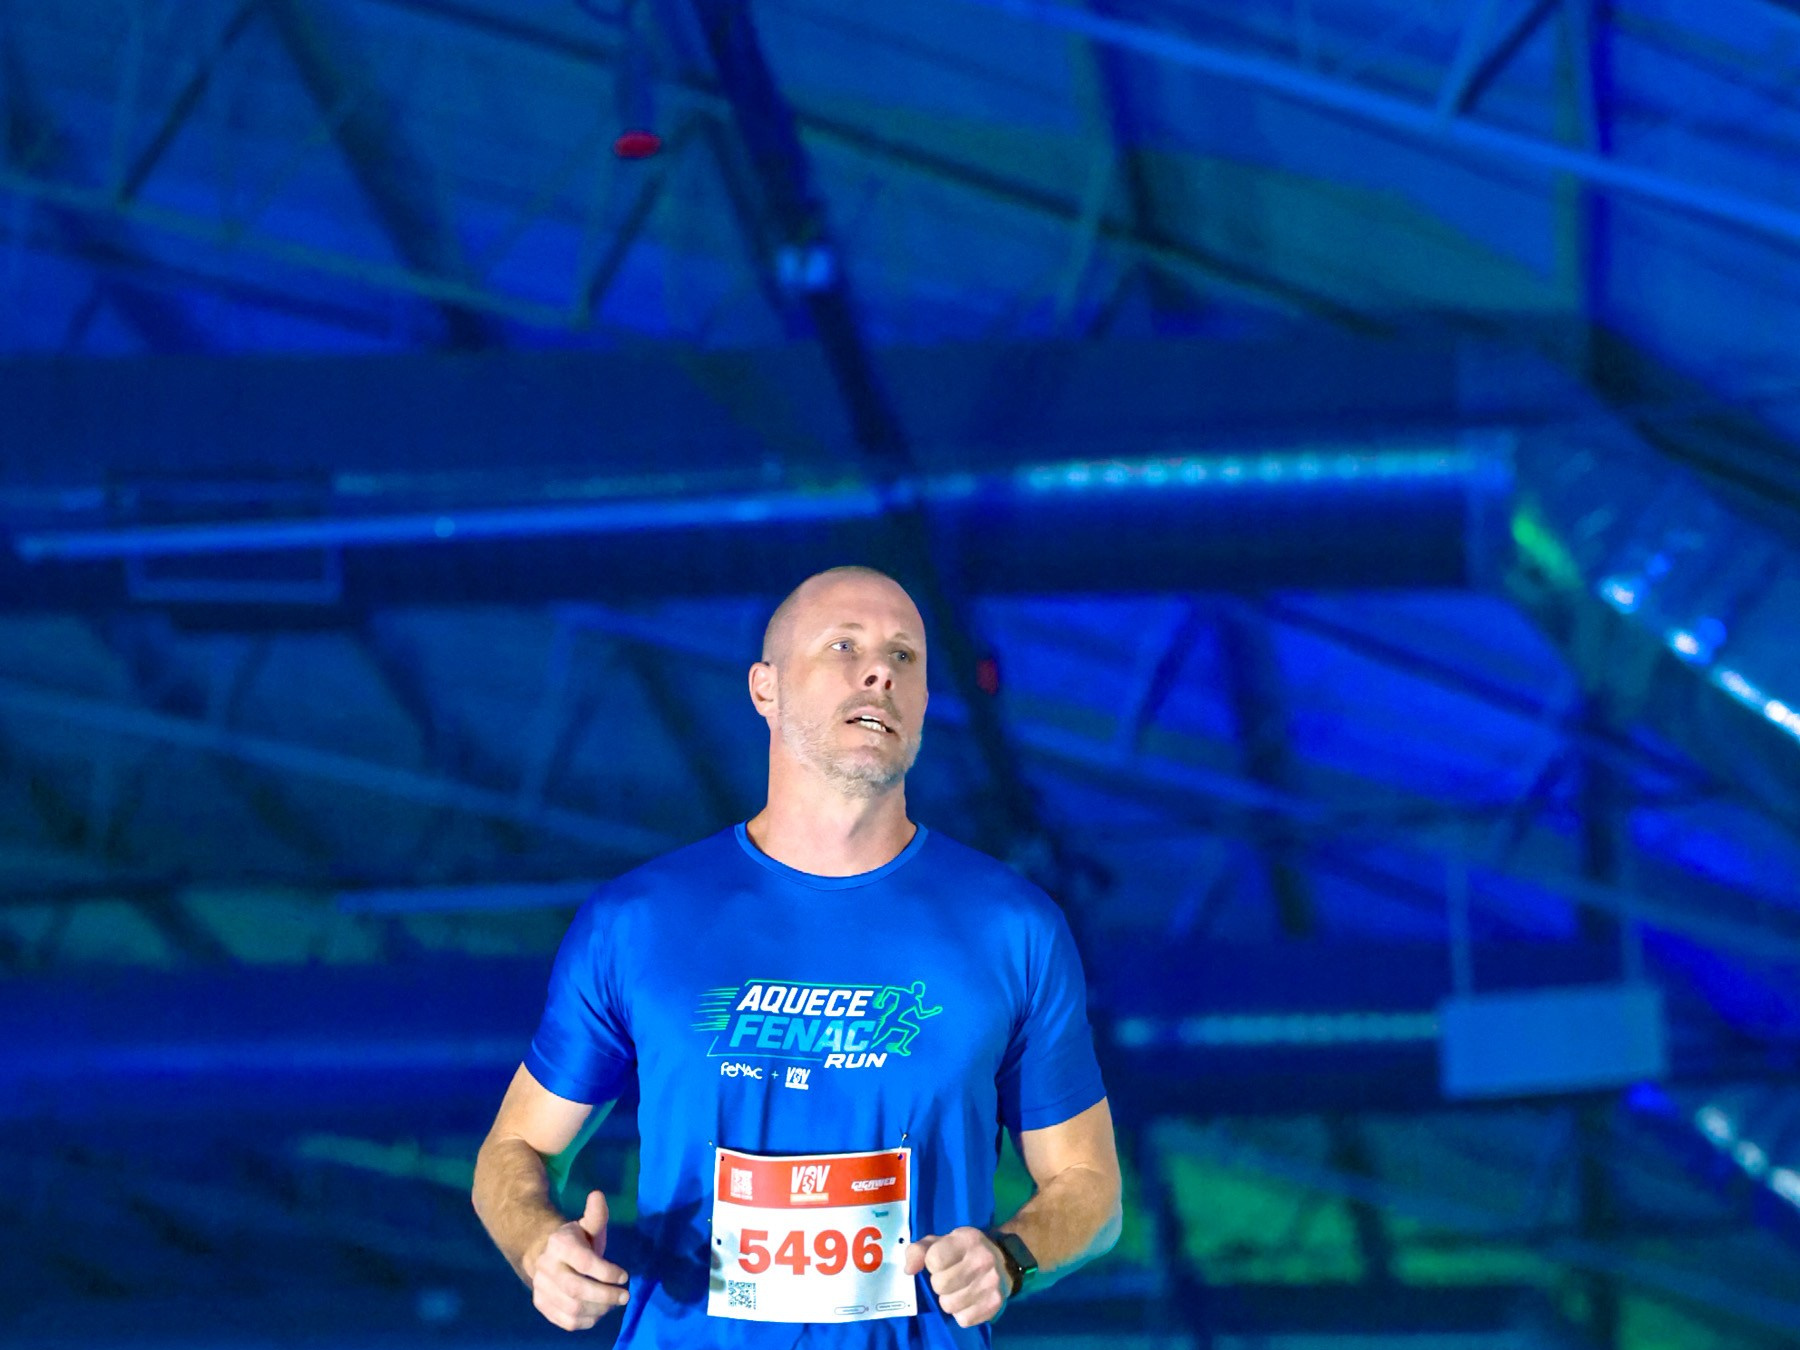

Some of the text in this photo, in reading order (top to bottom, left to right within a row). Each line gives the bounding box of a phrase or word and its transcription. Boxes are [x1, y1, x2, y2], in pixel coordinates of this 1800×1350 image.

[736, 985, 874, 1016] AQUECE
[729, 1014, 876, 1052] FENAC
[824, 1053, 887, 1068] RUN
[738, 1226, 883, 1275] 5496
